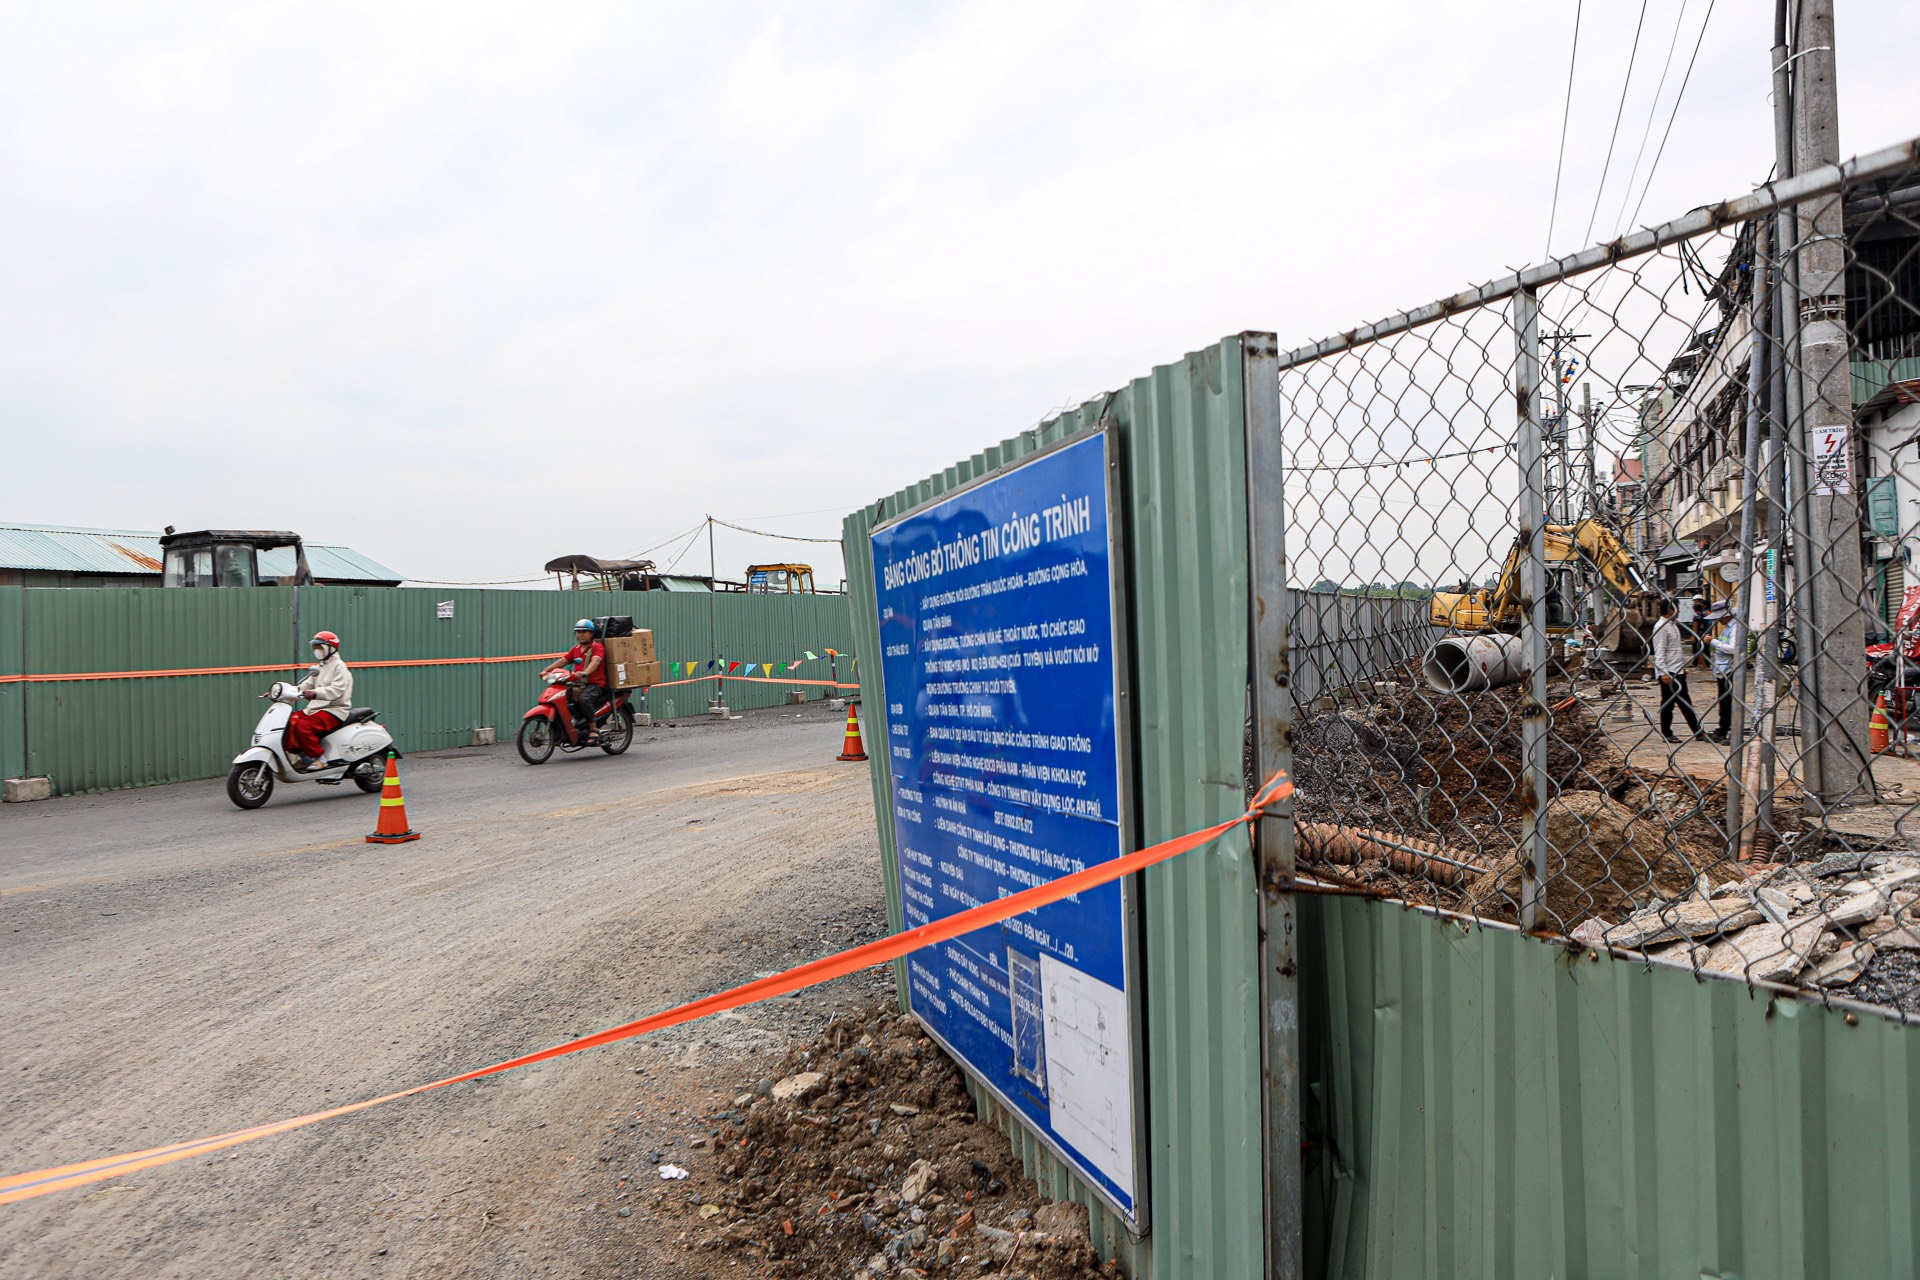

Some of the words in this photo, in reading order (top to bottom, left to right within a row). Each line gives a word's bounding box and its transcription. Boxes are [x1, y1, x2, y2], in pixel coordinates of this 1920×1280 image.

[884, 558, 905, 590] BẢNG
[905, 550, 930, 583] CÔNG
[931, 542, 944, 576] BỐ
[943, 533, 980, 571] THÔNG
[981, 527, 999, 560] TIN
[1002, 512, 1040, 554] CÔNG
[1043, 495, 1090, 541] TRÌNH
[1028, 568, 1050, 586] ĐƯỜNG
[1051, 563, 1070, 583] CỘNG
[1049, 619, 1067, 637] CHỨC
[1068, 619, 1085, 635] GIAO
[1044, 648, 1054, 665] VÀ
[1015, 731, 1031, 748] CÔNG
[1031, 732, 1049, 749] TRÌNH
[1050, 735, 1066, 751] GIAO
[1067, 734, 1091, 753] THÔNG
[1021, 762, 1037, 778] PHÂN
[1036, 766, 1050, 783] VIỆN
[1051, 768, 1070, 783] KHOA
[1070, 770, 1086, 788] HỌC
[1042, 793, 1061, 814] DỰNG
[1061, 796, 1076, 817] LỘC
[1076, 799, 1086, 814] AN
[1041, 849, 1053, 867] TÂN
[1053, 854, 1070, 872] PHÚC
